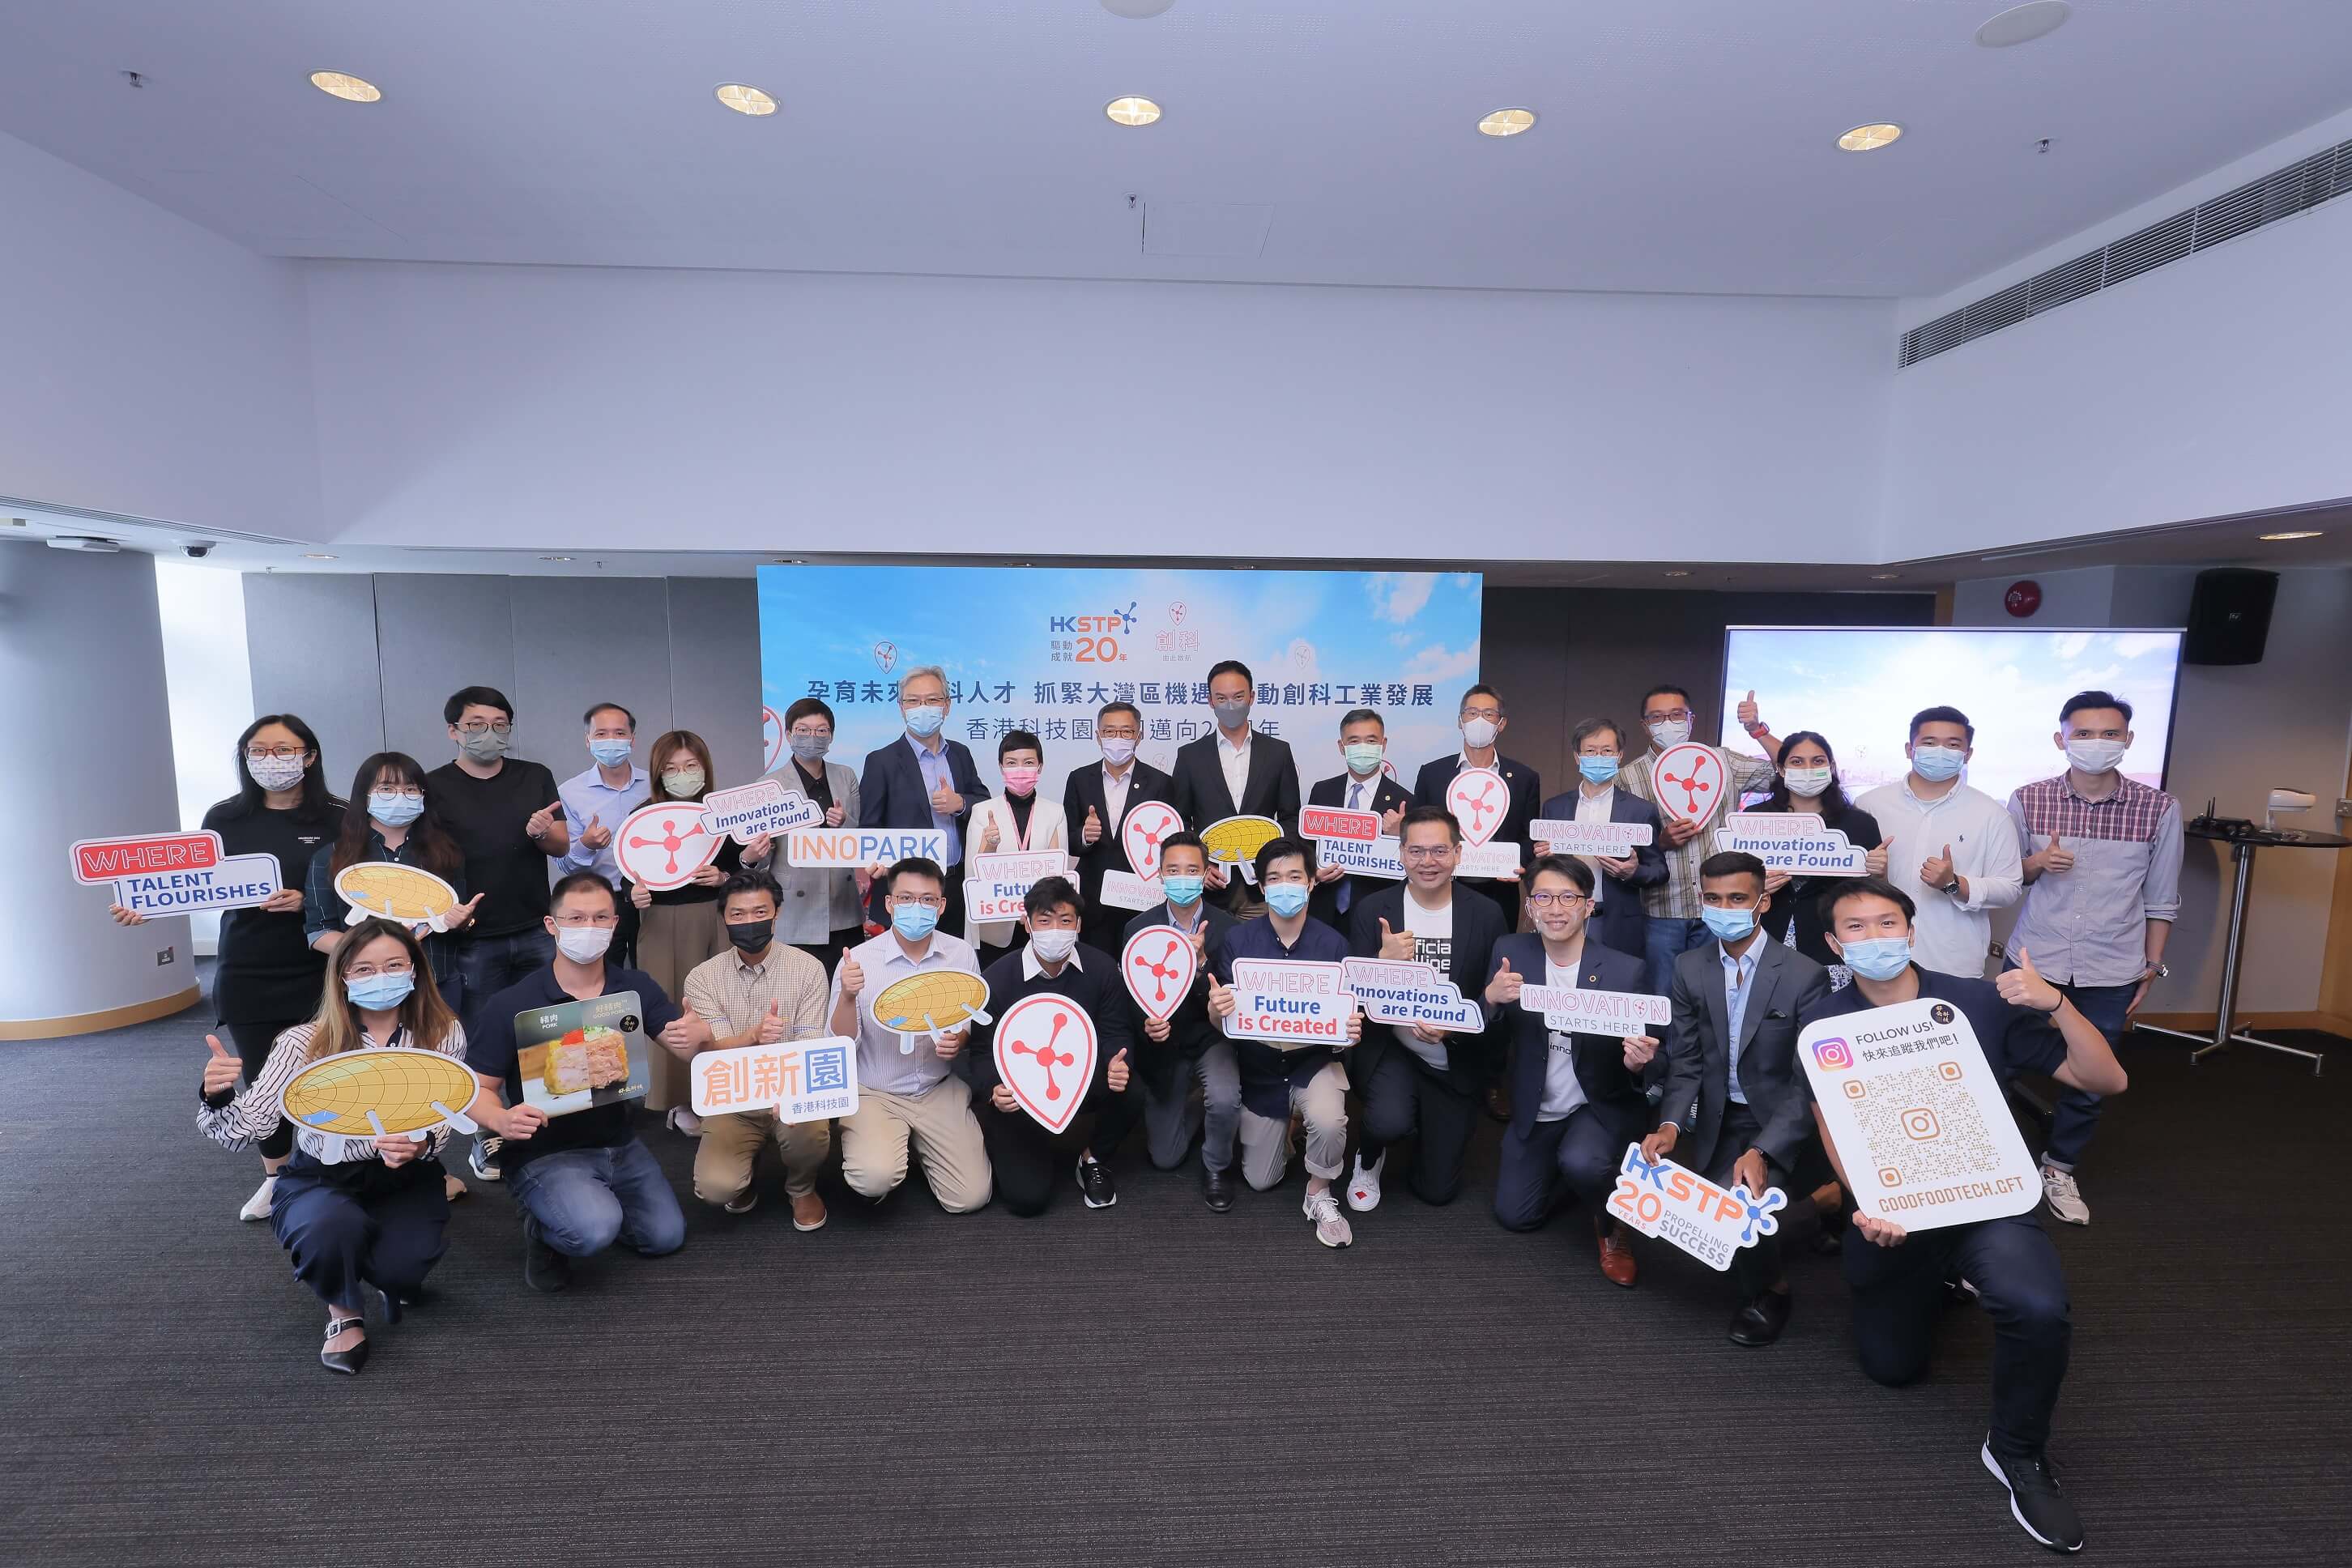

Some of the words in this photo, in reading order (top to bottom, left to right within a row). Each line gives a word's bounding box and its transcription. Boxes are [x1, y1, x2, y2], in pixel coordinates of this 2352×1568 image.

[1050, 616, 1122, 633] HKSTP
[1075, 637, 1118, 663] 20
[1155, 629, 1199, 652] 創科
[1050, 652, 1073, 662] 成就
[1118, 654, 1127, 662] 年
[807, 680, 1016, 704] 孕育未來科人才
[1257, 682, 1434, 707] 動創科工業發展
[714, 786, 778, 815] WHERE
[715, 800, 795, 829] Innovations
[745, 818, 769, 836] are
[770, 807, 811, 830] Found
[1305, 814, 1374, 837] WHERE
[1736, 820, 1816, 837] WHERE
[792, 835, 940, 861] INNOPARK
[1323, 839, 1374, 855] TALENT
[1553, 842, 1593, 853] STARTS
[1597, 845, 1626, 854] HERE
[1732, 837, 1836, 852] Innovations
[83, 842, 209, 873] WHERE
[1323, 852, 1404, 871] FLOURISHES
[1765, 854, 1793, 867] are
[1798, 854, 1855, 867] Found
[982, 859, 1057, 880] WHERE
[127, 871, 214, 893] TALENT
[994, 883, 1032, 897] Futu
[131, 882, 272, 910] FLOURISHES
[980, 901, 994, 915] is
[1242, 971, 1330, 995] WHERE
[1353, 966, 1428, 987] WHERE
[1350, 983, 1449, 1004] Innovations
[1255, 995, 1321, 1015] Future
[1382, 1003, 1408, 1017] are
[1412, 1004, 1466, 1023] Found
[1238, 1012, 1254, 1030] is
[1259, 1015, 1338, 1036] Created
[1550, 1015, 1598, 1030] STARTS
[1603, 1022, 1640, 1035] HERE
[1856, 1025, 1910, 1046] FOLLOW
[1912, 1020, 1935, 1033] US!
[702, 1046, 848, 1107] 創新園
[791, 1096, 849, 1114] 香港科技園
[1626, 1148, 1743, 1223] HKSTP
[1613, 1181, 1661, 1222] 20
[1618, 1208, 1647, 1229] YEARS
[1664, 1210, 1730, 1253] PROPELLING
[1660, 1220, 1725, 1265] SUCCESS
